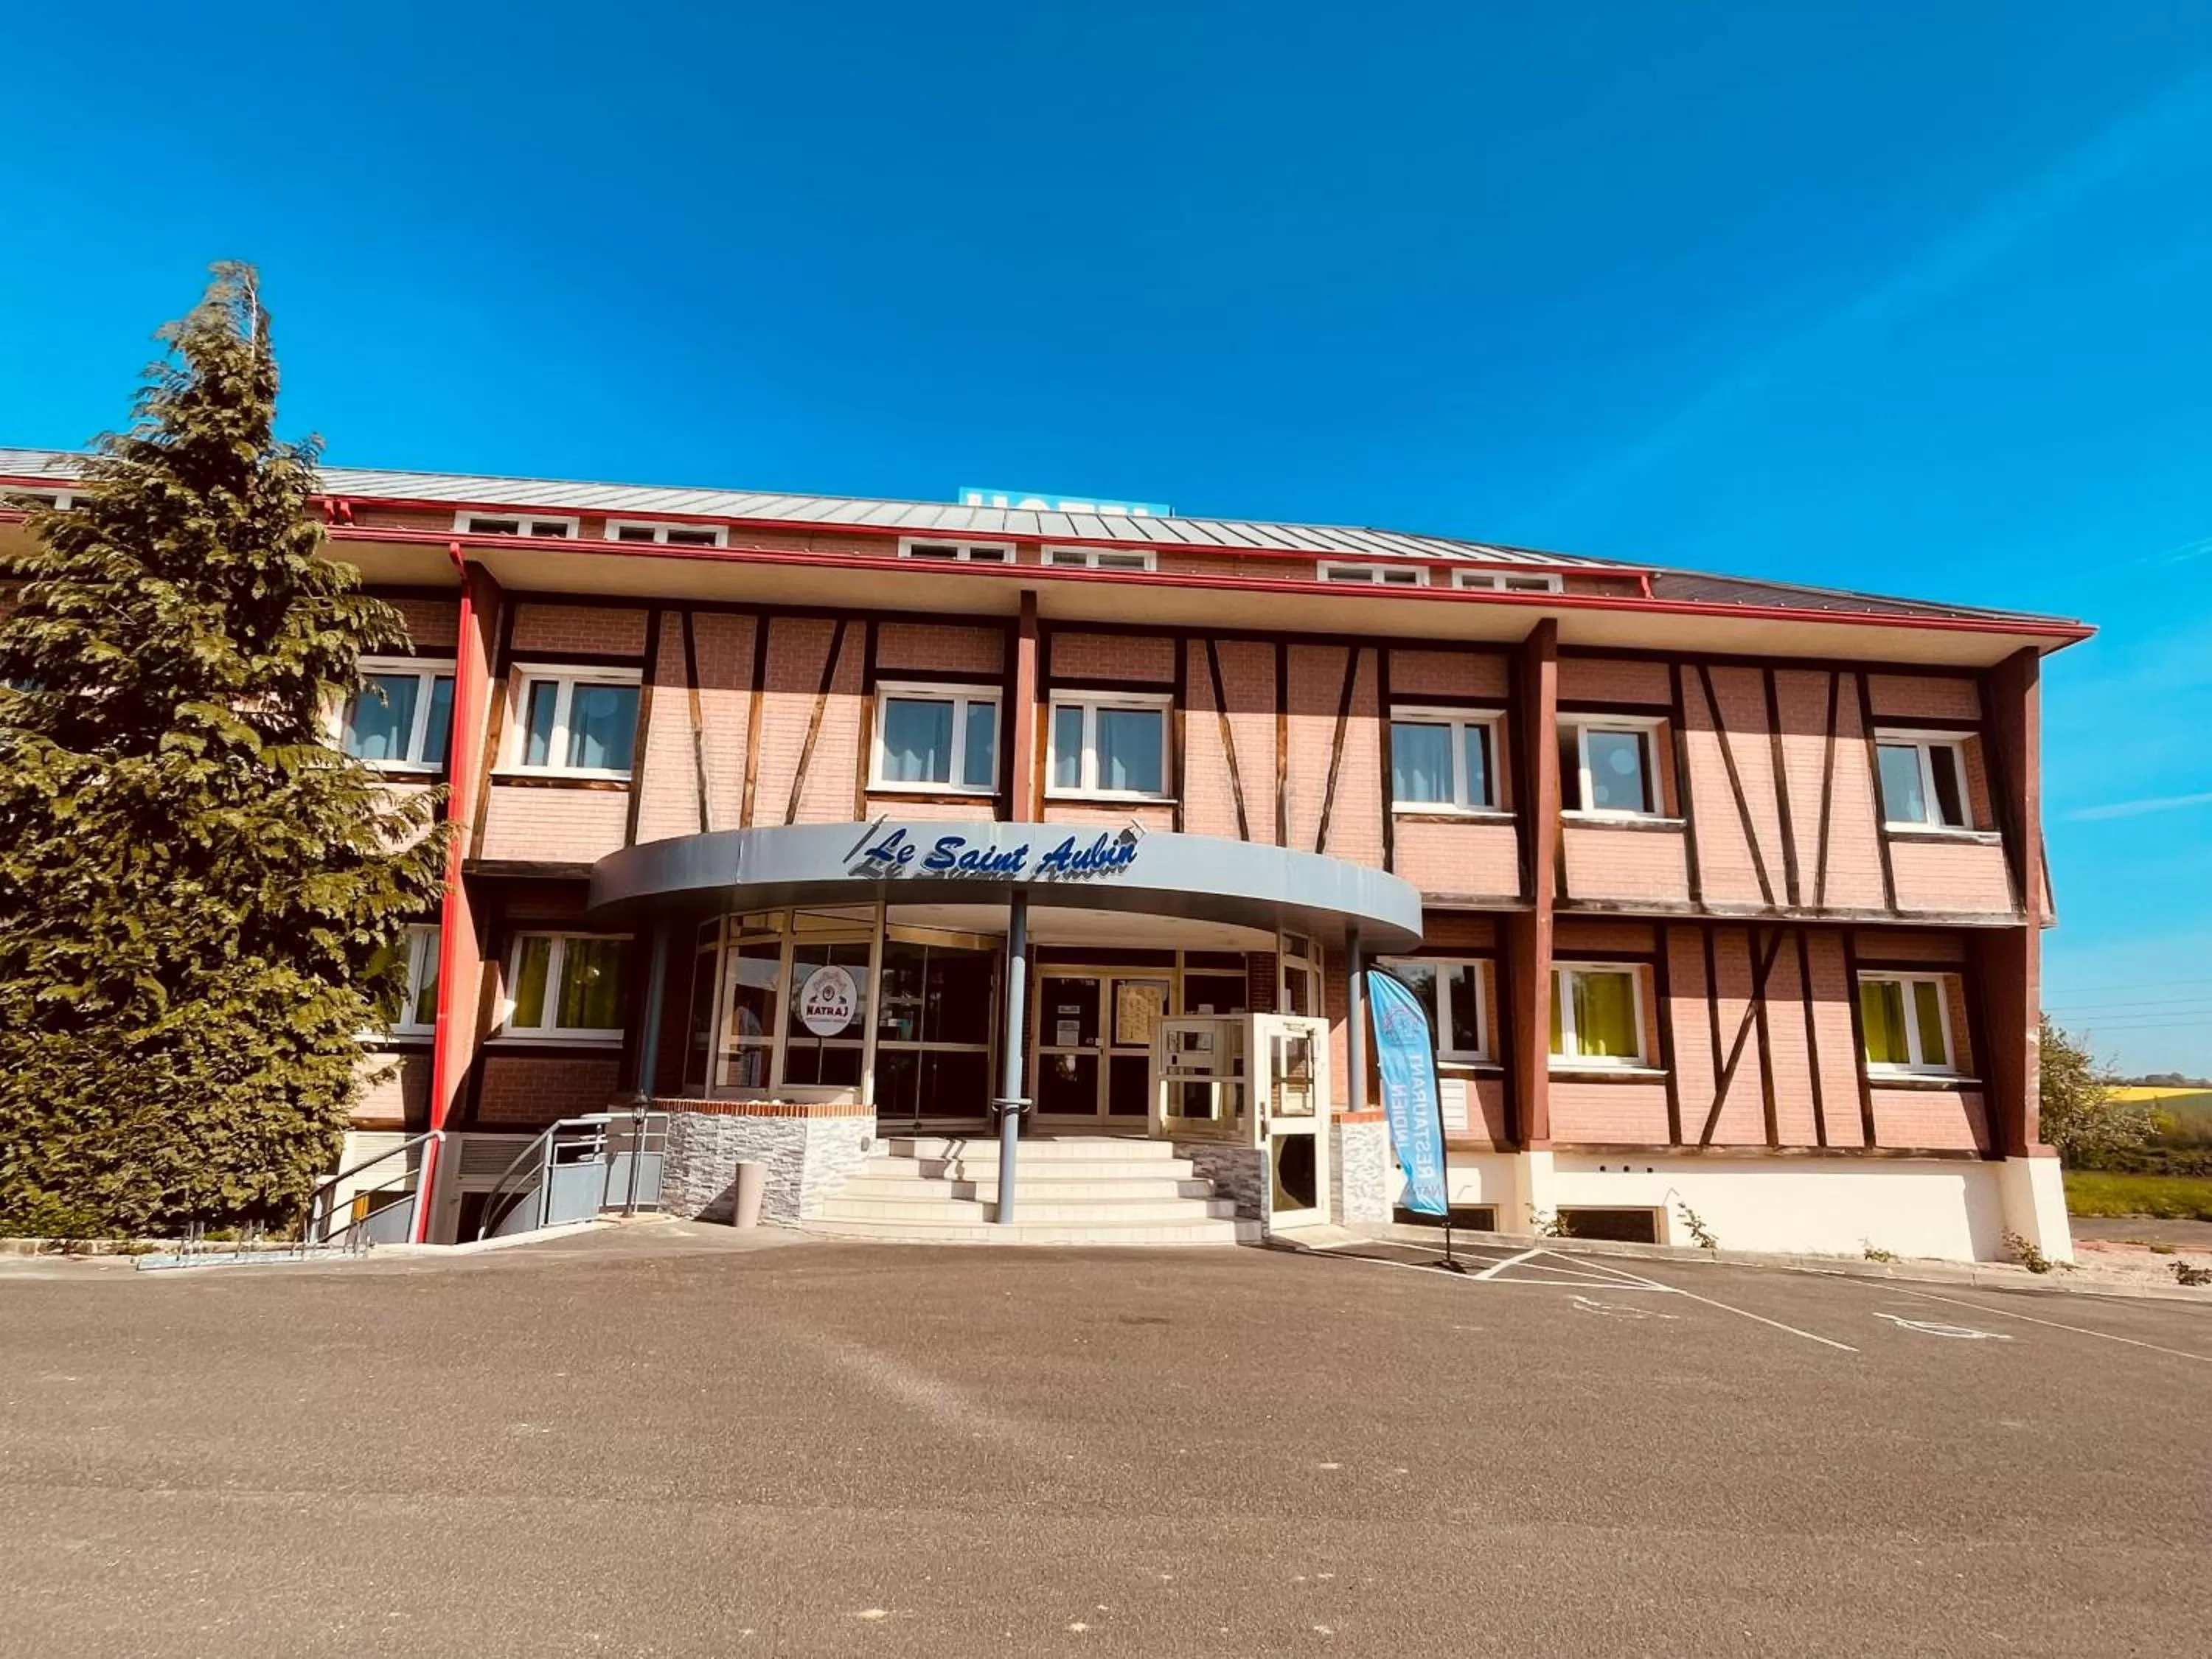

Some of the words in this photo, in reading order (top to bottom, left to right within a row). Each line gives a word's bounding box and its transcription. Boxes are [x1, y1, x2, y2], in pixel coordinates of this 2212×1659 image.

[864, 828, 916, 863] Le
[923, 836, 1029, 872] Saint
[1036, 831, 1138, 874] Aubin
[807, 1005, 849, 1017] NATRAJ
